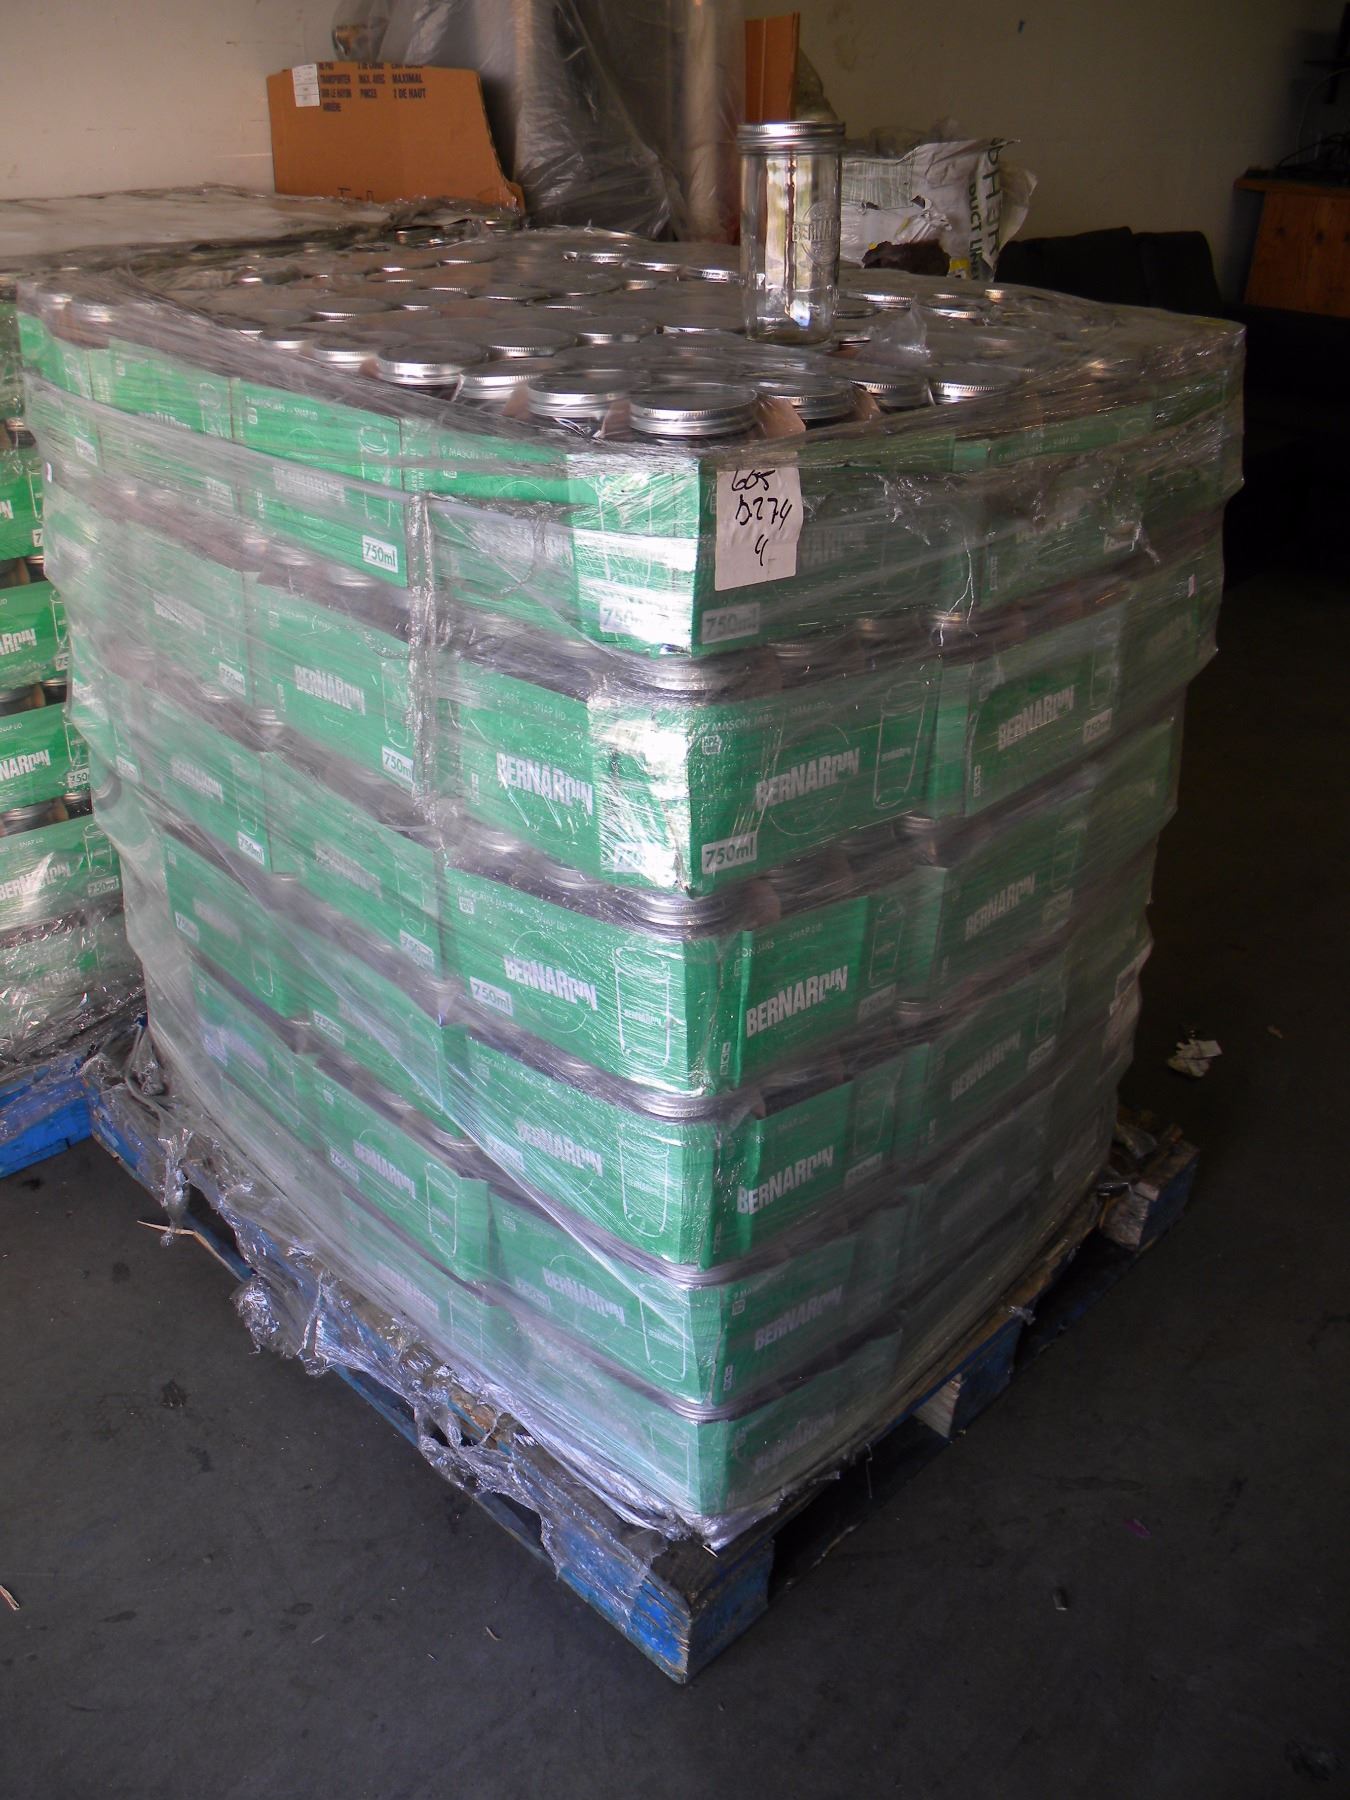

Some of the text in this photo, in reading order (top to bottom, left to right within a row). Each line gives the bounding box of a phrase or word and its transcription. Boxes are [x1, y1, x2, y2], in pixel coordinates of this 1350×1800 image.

[409, 87, 426, 98] HAUT
[968, 182, 982, 232] DUCT
[731, 469, 776, 492] 605
[363, 540, 397, 568] 750ml
[705, 606, 759, 636] 750ml
[293, 665, 367, 716] BERNARDIN
[998, 684, 1075, 751] BERNARDIN
[0, 749, 51, 781] NARDIN
[496, 751, 593, 817] BERNARDIN
[755, 747, 861, 812] BERNARDIN
[704, 831, 755, 868] 750ml
[472, 981, 512, 1013] 750ml
[503, 955, 598, 1011] BERNARDIN
[746, 965, 849, 1039] BERNARDIN
[737, 1145, 834, 1216] BERNARDIN
[754, 1284, 843, 1351] BERNARDIN
